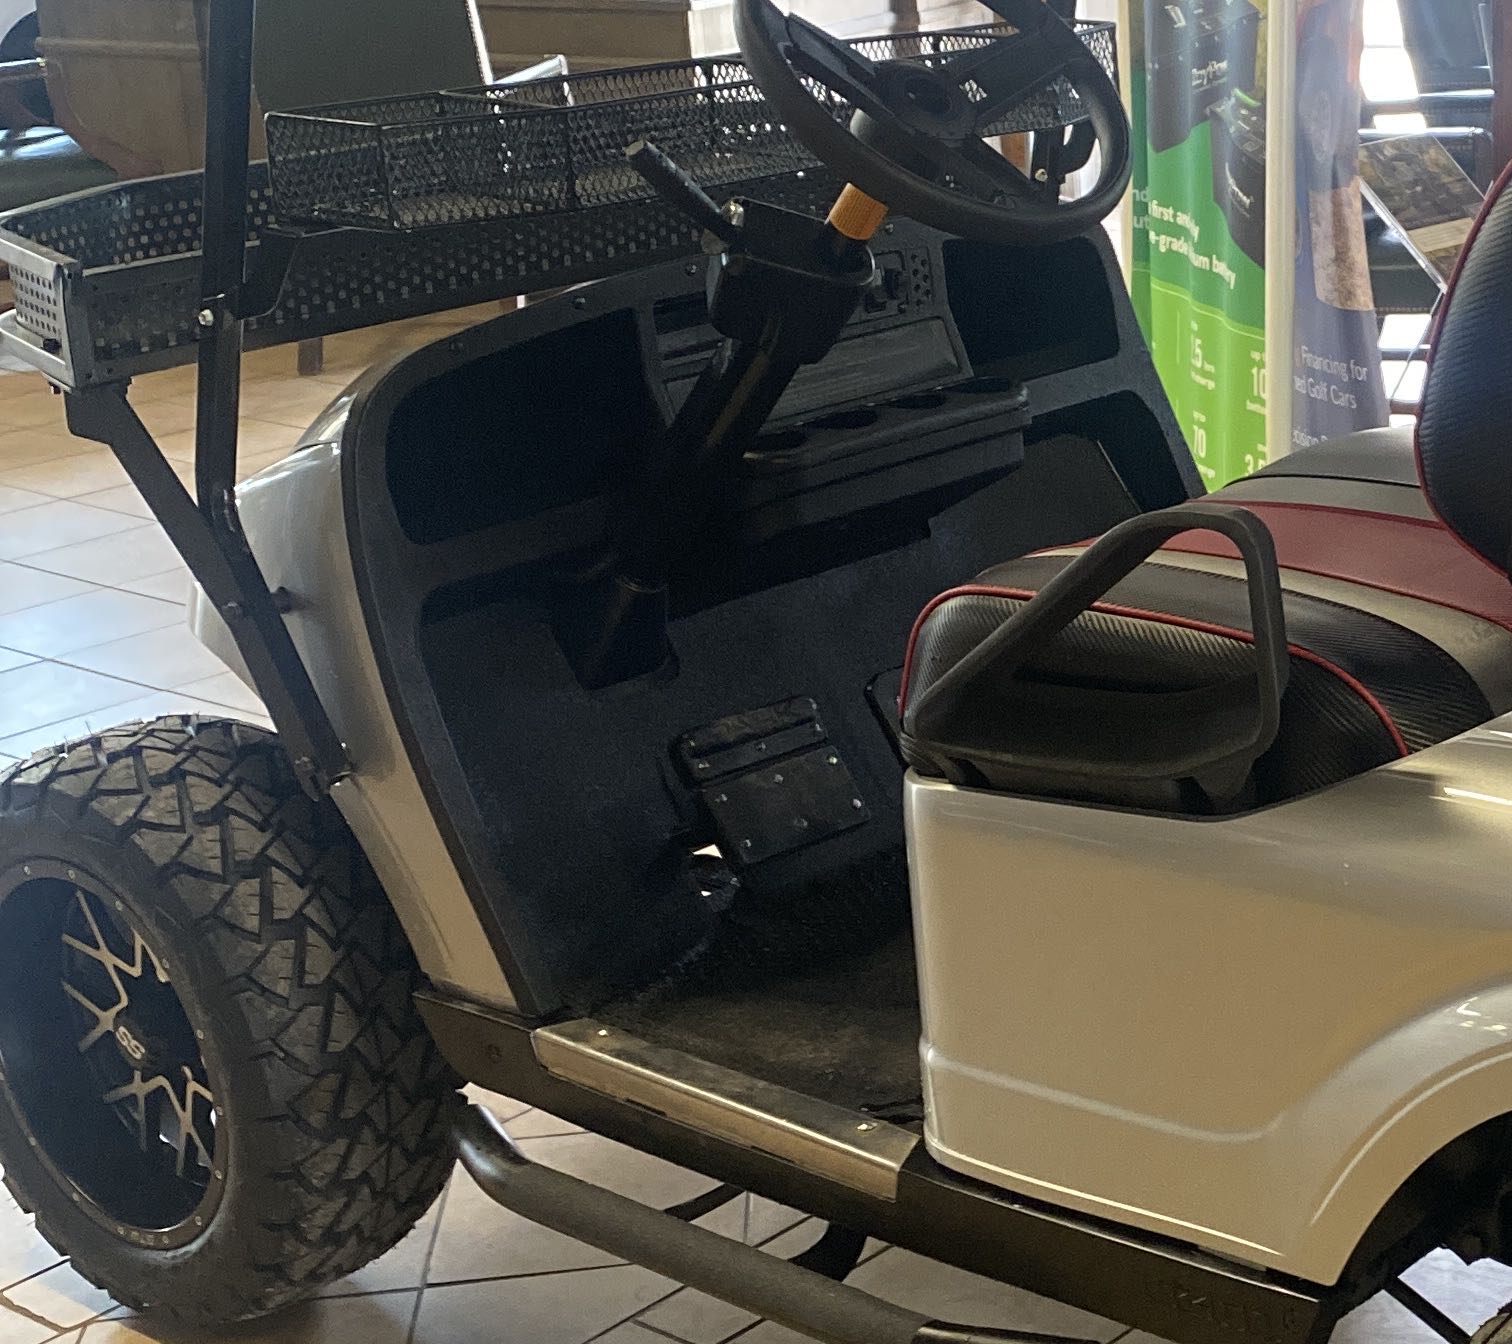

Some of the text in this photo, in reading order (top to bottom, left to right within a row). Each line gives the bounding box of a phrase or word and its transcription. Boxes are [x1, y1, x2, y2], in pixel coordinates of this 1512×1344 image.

[1301, 346, 1368, 383] Financing for
[1330, 385, 1357, 410] Cars
